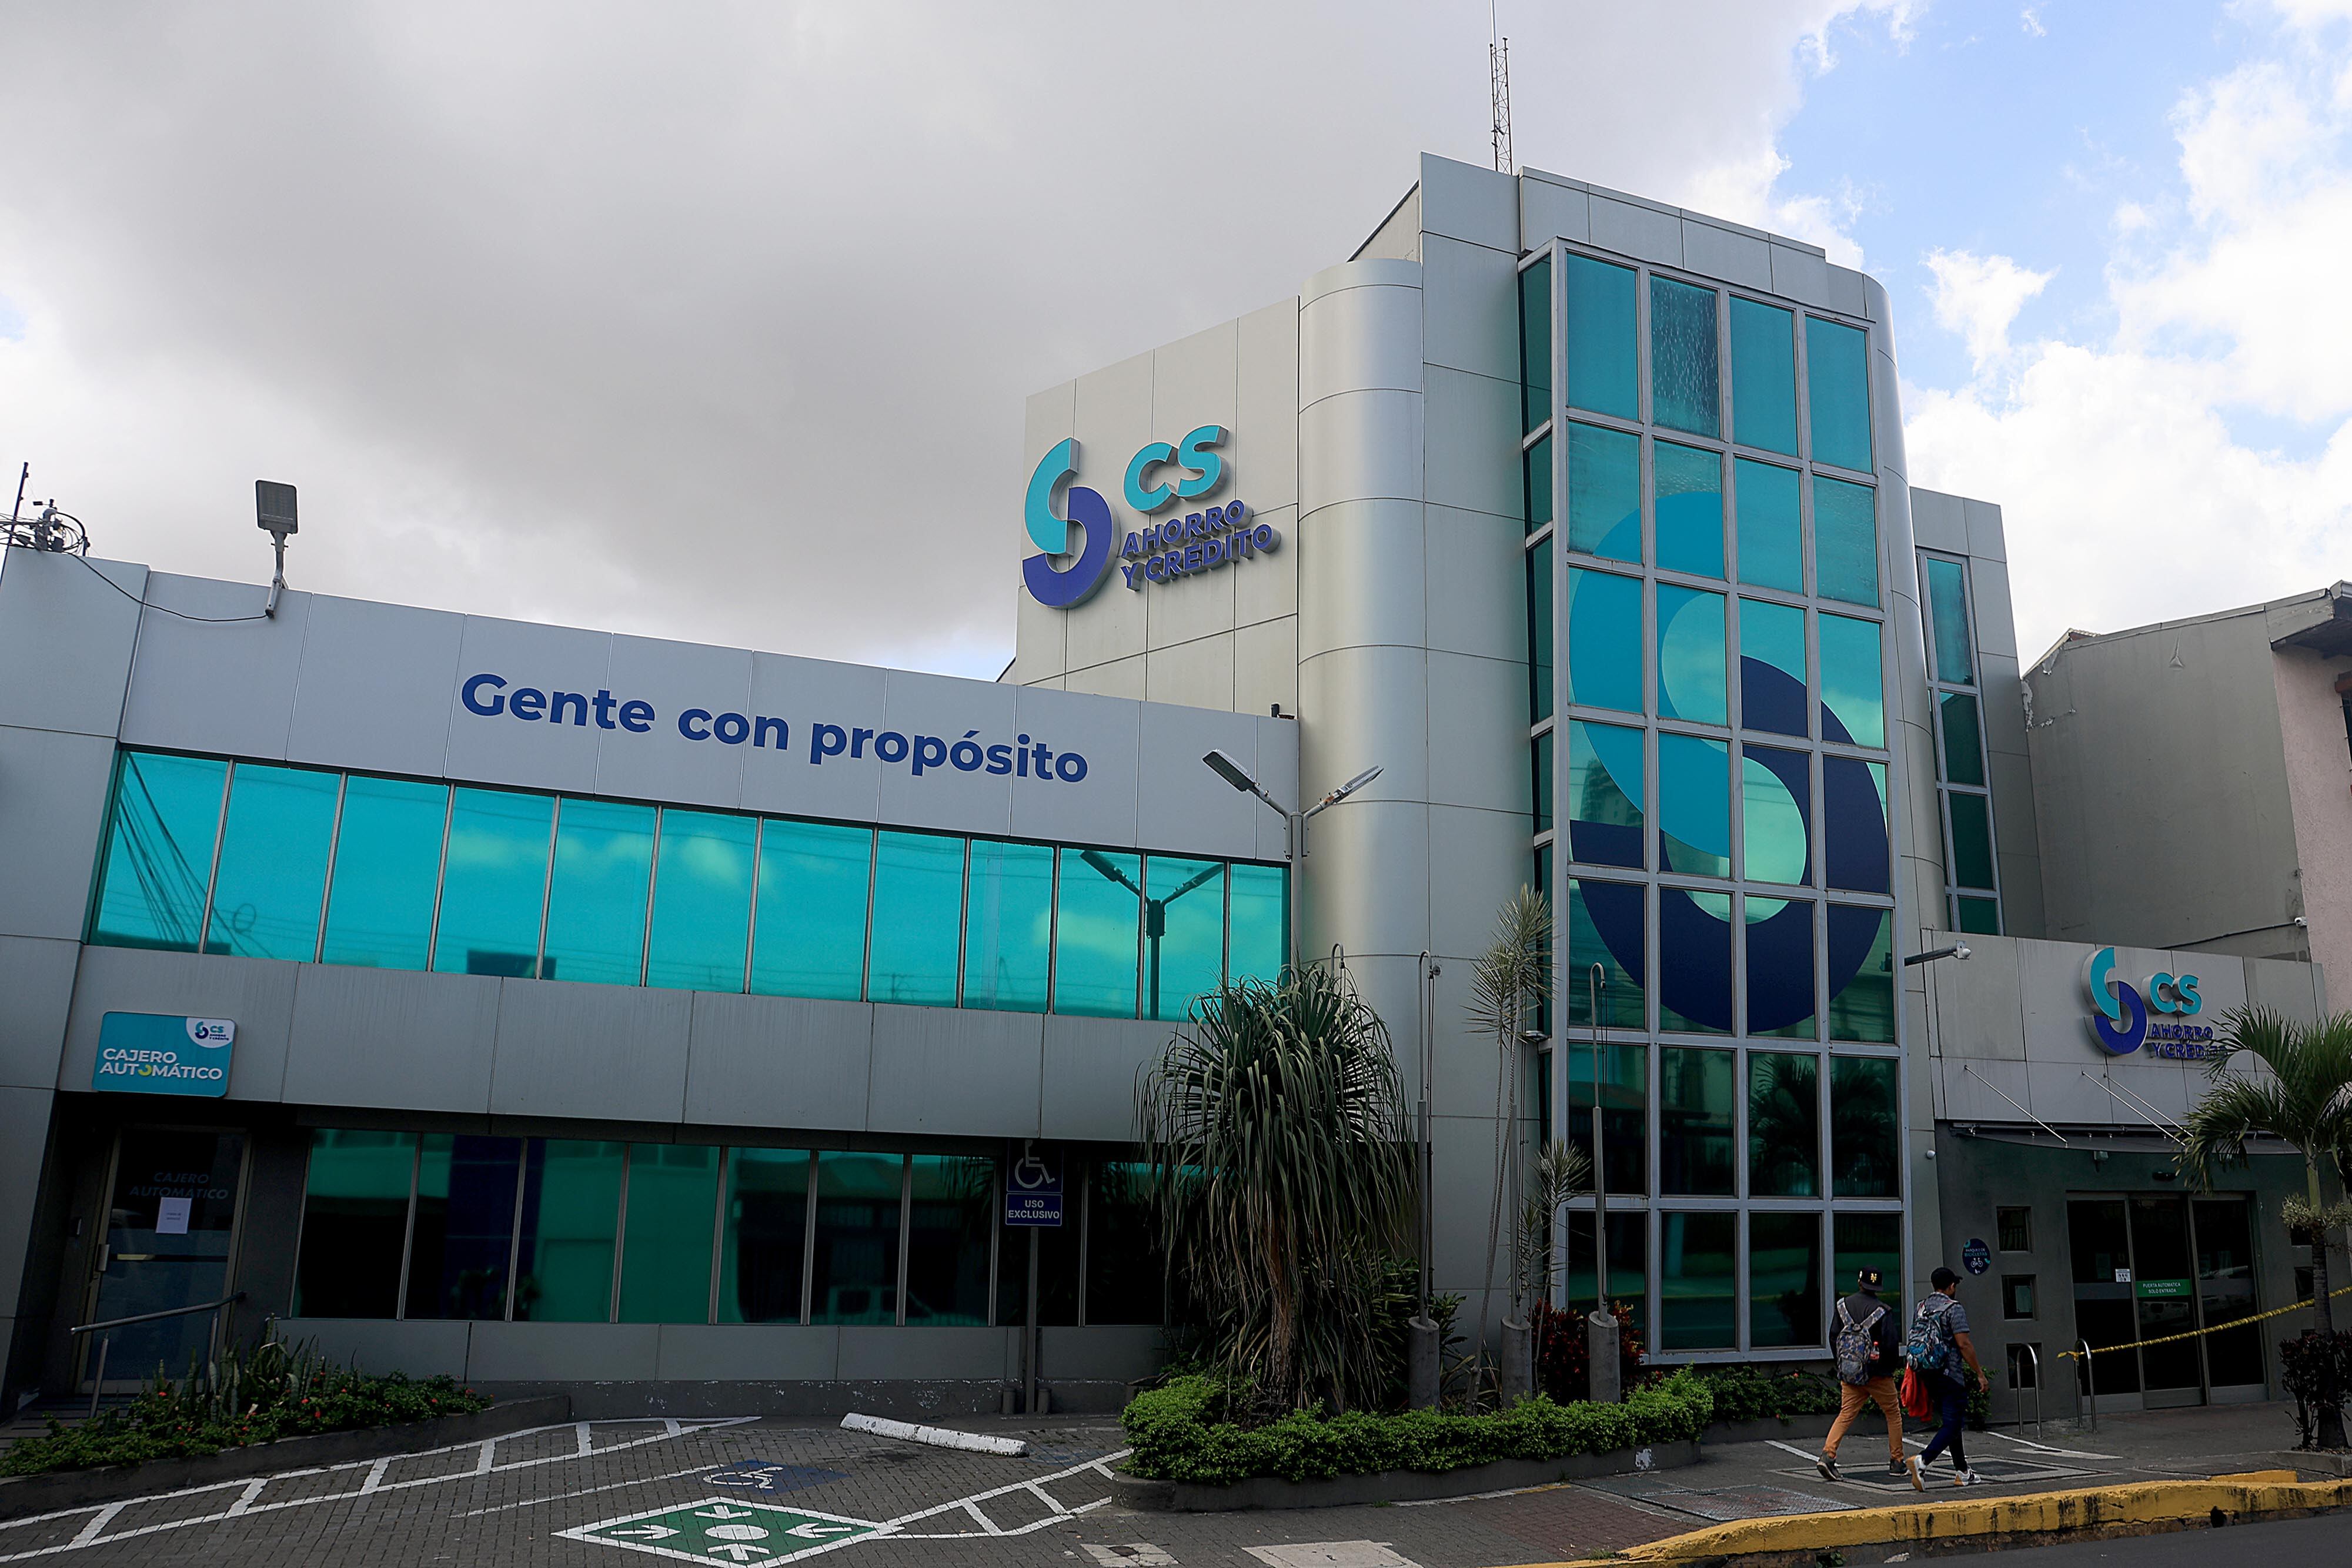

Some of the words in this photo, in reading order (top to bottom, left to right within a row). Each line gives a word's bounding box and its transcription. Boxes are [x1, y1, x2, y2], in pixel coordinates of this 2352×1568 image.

[1122, 424, 1228, 514] CS
[1121, 499, 1249, 559] AHORRO
[1120, 562, 1141, 590] Y
[1144, 523, 1276, 582] CRÉDITO
[461, 673, 656, 734] Gente
[677, 707, 790, 751] con
[810, 721, 1089, 784] propósito
[2146, 972, 2203, 1015] CS
[210, 1025, 224, 1034] CS
[2150, 1023, 2214, 1041] AHORRO
[102, 1048, 177, 1064] CAJERO
[2151, 1042, 2161, 1057] Y
[99, 1062, 223, 1081] AUTOMÁTICO
[153, 1172, 209, 1184] CAJERO
[1025, 1200, 1044, 1208] USO
[1008, 1210, 1060, 1219] EXCLUSIVO
